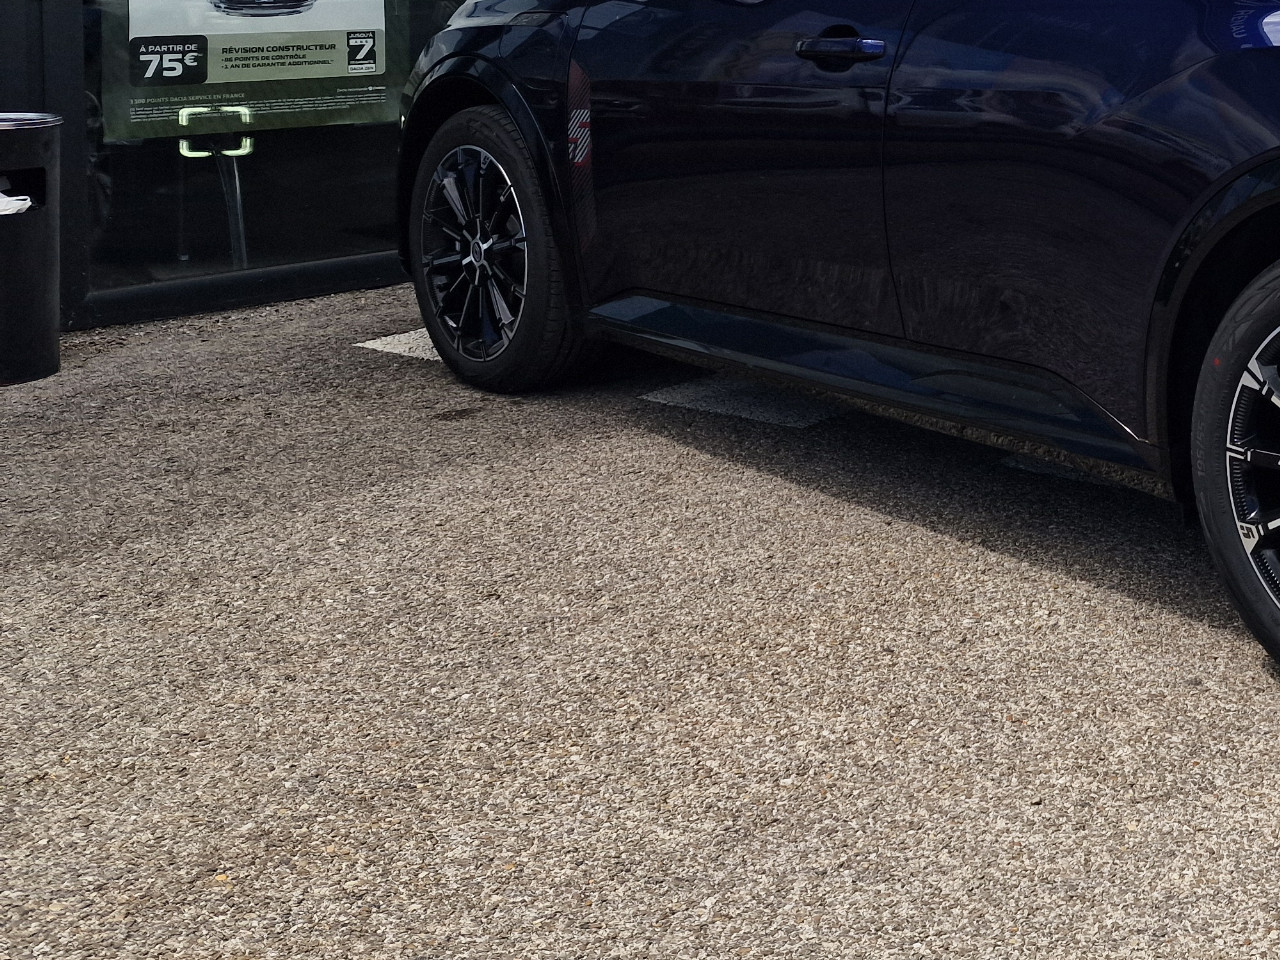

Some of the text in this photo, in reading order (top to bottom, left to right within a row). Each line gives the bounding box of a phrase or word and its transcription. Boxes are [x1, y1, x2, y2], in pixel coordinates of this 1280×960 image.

[148, 45, 183, 53] PARTIR
[222, 44, 337, 54] RÉVISION CONSTRUCTEUR
[349, 38, 374, 60] 7
